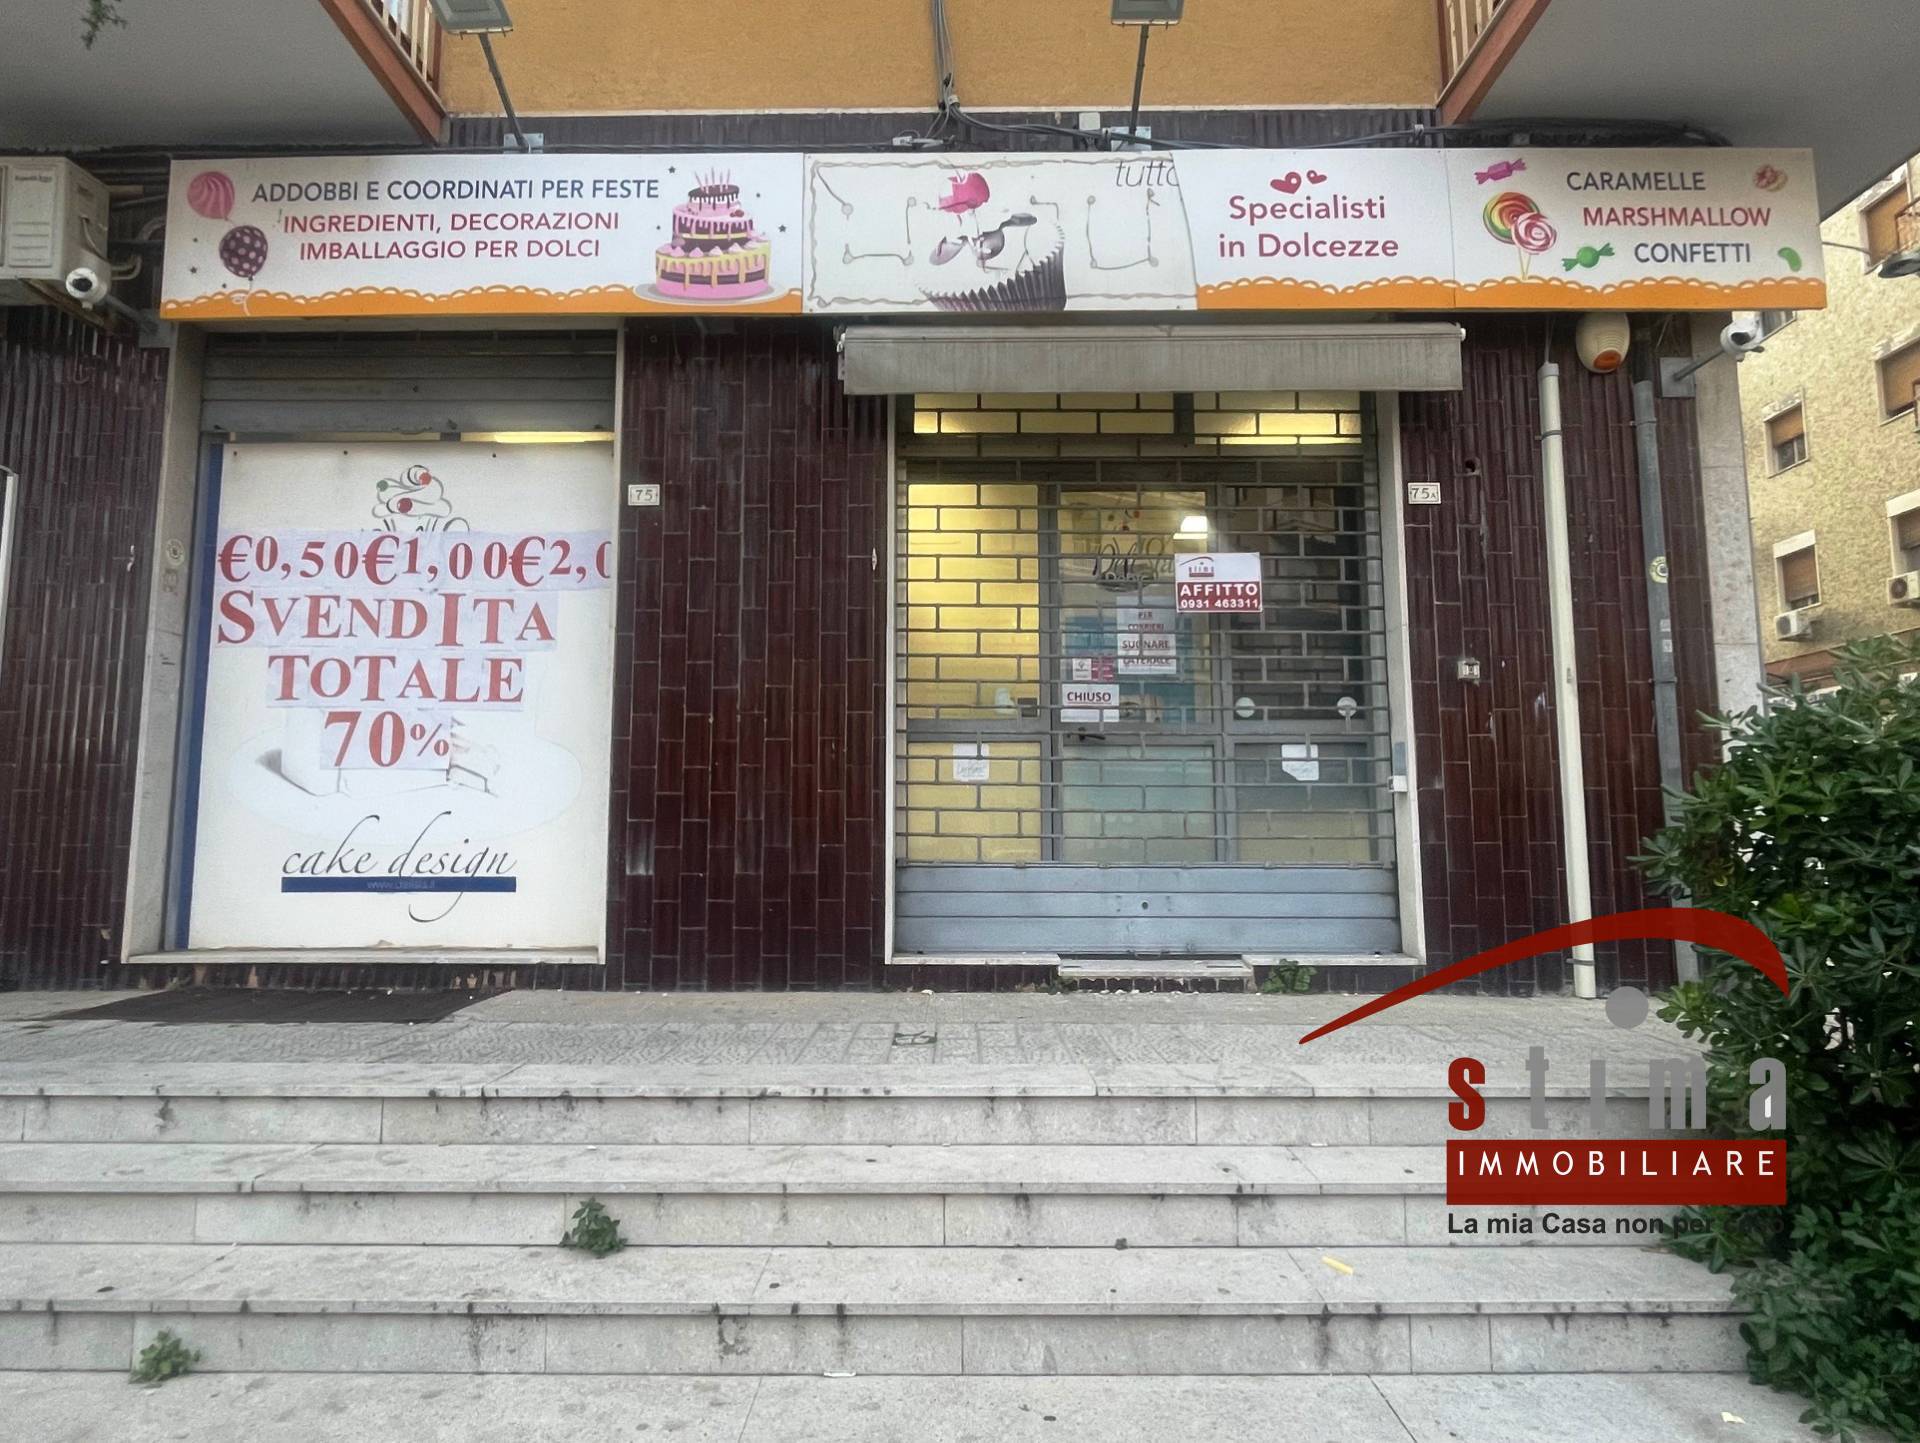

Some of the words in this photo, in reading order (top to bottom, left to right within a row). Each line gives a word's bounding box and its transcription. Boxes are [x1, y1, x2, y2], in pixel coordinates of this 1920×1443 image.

[251, 180, 358, 202] ADDOBBI
[366, 180, 381, 200] E
[386, 176, 533, 200] COORDINATI
[541, 178, 585, 199] PER
[592, 177, 660, 199] FESTE
[1566, 171, 1706, 192] CARAMELLE
[1228, 194, 1387, 226] Specialisti
[1583, 206, 1771, 227] MARSHMALLOW
[283, 212, 442, 235] INGREDIENTI,
[450, 211, 620, 232] DECORAZIONI
[299, 239, 466, 261] IMBALLAGGIO
[474, 240, 518, 259] PER
[526, 238, 601, 259] DOLCI
[1218, 231, 1246, 259] in
[1258, 230, 1400, 259] Dolcezze
[1634, 242, 1751, 264] CONFETTI
[635, 488, 653, 501] 75
[1180, 584, 1258, 597] AFFITTO
[1180, 599, 1209, 609] 0931
[1214, 598, 1259, 608] 463311
[217, 588, 556, 648] SVENDITA
[267, 653, 525, 704] TOTALE
[1066, 691, 1112, 702] CHIUSO
[323, 709, 451, 769] 70%
[282, 814, 380, 876] cake
[387, 810, 517, 923] design
